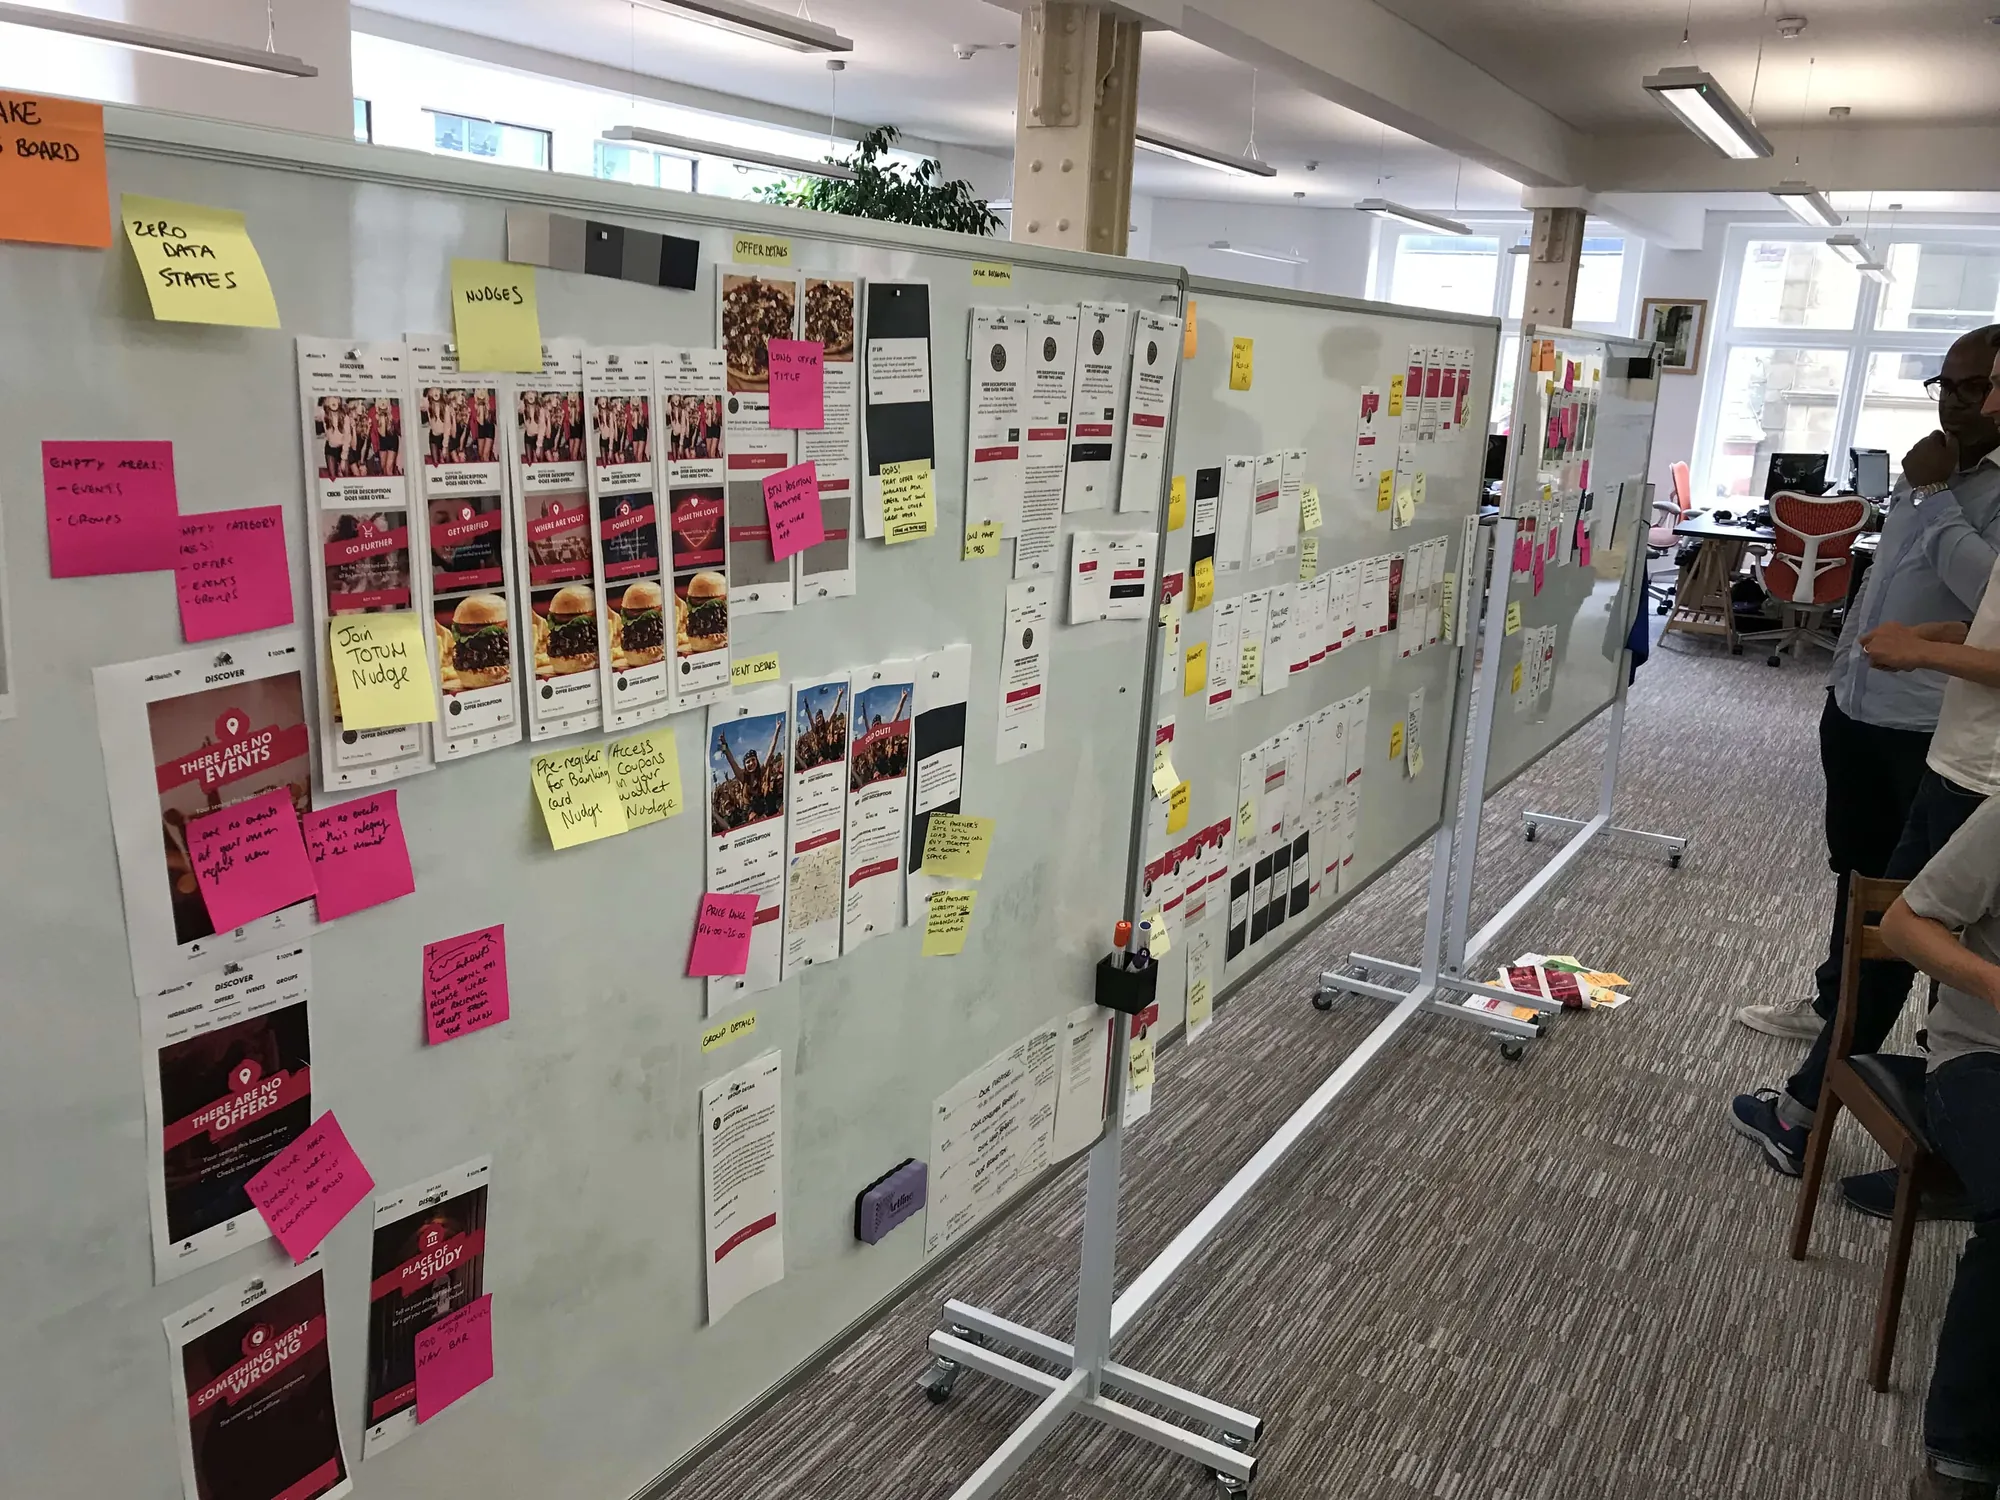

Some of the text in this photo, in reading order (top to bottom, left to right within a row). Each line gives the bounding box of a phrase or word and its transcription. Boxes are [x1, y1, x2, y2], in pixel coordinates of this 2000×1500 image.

[16, 138, 80, 162] BOARD
[133, 221, 187, 239] ZERO
[162, 242, 216, 259] DATA
[735, 240, 764, 255] OFFER
[159, 268, 237, 289] STATES
[466, 285, 524, 305] NUDGES
[771, 351, 817, 366] LONG OFFER
[774, 372, 801, 382] TITLE
[50, 457, 106, 472] EMPTY
[882, 464, 901, 475] OOPS!
[72, 483, 123, 496] EVENTS
[359, 487, 392, 495] DESCRIPTION
[767, 476, 812, 500] BTN POSITION
[882, 478, 896, 486] THAT
[68, 514, 122, 527] GROUPS
[226, 517, 276, 531] CATEGORY
[534, 513, 584, 534] WHERE ARE YOU?
[612, 514, 644, 531] POWER IT UP
[677, 506, 719, 524] SHARE THE LOVE
[447, 520, 489, 537] GET VERIFIED
[346, 537, 393, 555] GO FURTHER
[192, 576, 237, 590] EVENTS
[194, 590, 239, 605] GROUPS
[337, 625, 373, 647] Join
[346, 642, 407, 665] TOTUM
[205, 669, 245, 683] DISCOVER
[352, 663, 411, 690] Nudge
[753, 660, 777, 674] DETAILS
[476, 698, 503, 709] DESCRIPTION
[361, 726, 406, 740] OFFER DESCRIPTION
[865, 726, 891, 745] SOLD OUT!
[180, 732, 272, 776] THERE ARE NO
[612, 739, 654, 758] Access
[205, 745, 271, 783] EVENTS
[536, 748, 601, 777] Pre-register
[546, 766, 610, 793] for Banking
[616, 768, 660, 788] in your
[619, 780, 670, 801] wallet
[229, 806, 278, 830] no events
[338, 802, 380, 824] no events
[561, 803, 602, 829] Nudge
[626, 798, 677, 819] Nudge
[326, 827, 348, 843] this
[198, 849, 211, 863] at
[315, 851, 325, 862] at
[202, 850, 270, 885] right now
[706, 904, 725, 918] PRICE
[215, 974, 254, 991] DISCOVER
[167, 974, 298, 1019] HIGHLIGHTS OFFERS EVENTS GROUPS
[702, 1016, 756, 1047] GROUP DETAILS
[192, 1077, 282, 1129] THERE ARE NO
[214, 1090, 278, 1131] OFFERS
[203, 1126, 288, 1162] Your seeing this because there
[217, 1168, 235, 1178] Check
[246, 1157, 262, 1166] other
[221, 1157, 238, 1166] offers
[273, 1154, 300, 1177] YOUR
[263, 1178, 296, 1209] DOESN'T
[271, 1158, 340, 1222] OFFERS ARE NOT
[280, 1172, 344, 1234] LOCATION BASED
[402, 1244, 448, 1279] PLACE OF
[421, 1245, 463, 1281] STUDY
[241, 1289, 267, 1307] TOTUM
[395, 1307, 404, 1316] Tell
[418, 1332, 469, 1367] NAV BAR
[198, 1320, 309, 1406] SOMETHING WENT
[231, 1340, 301, 1394] WRONG
[220, 1388, 282, 1427] The internet connection
